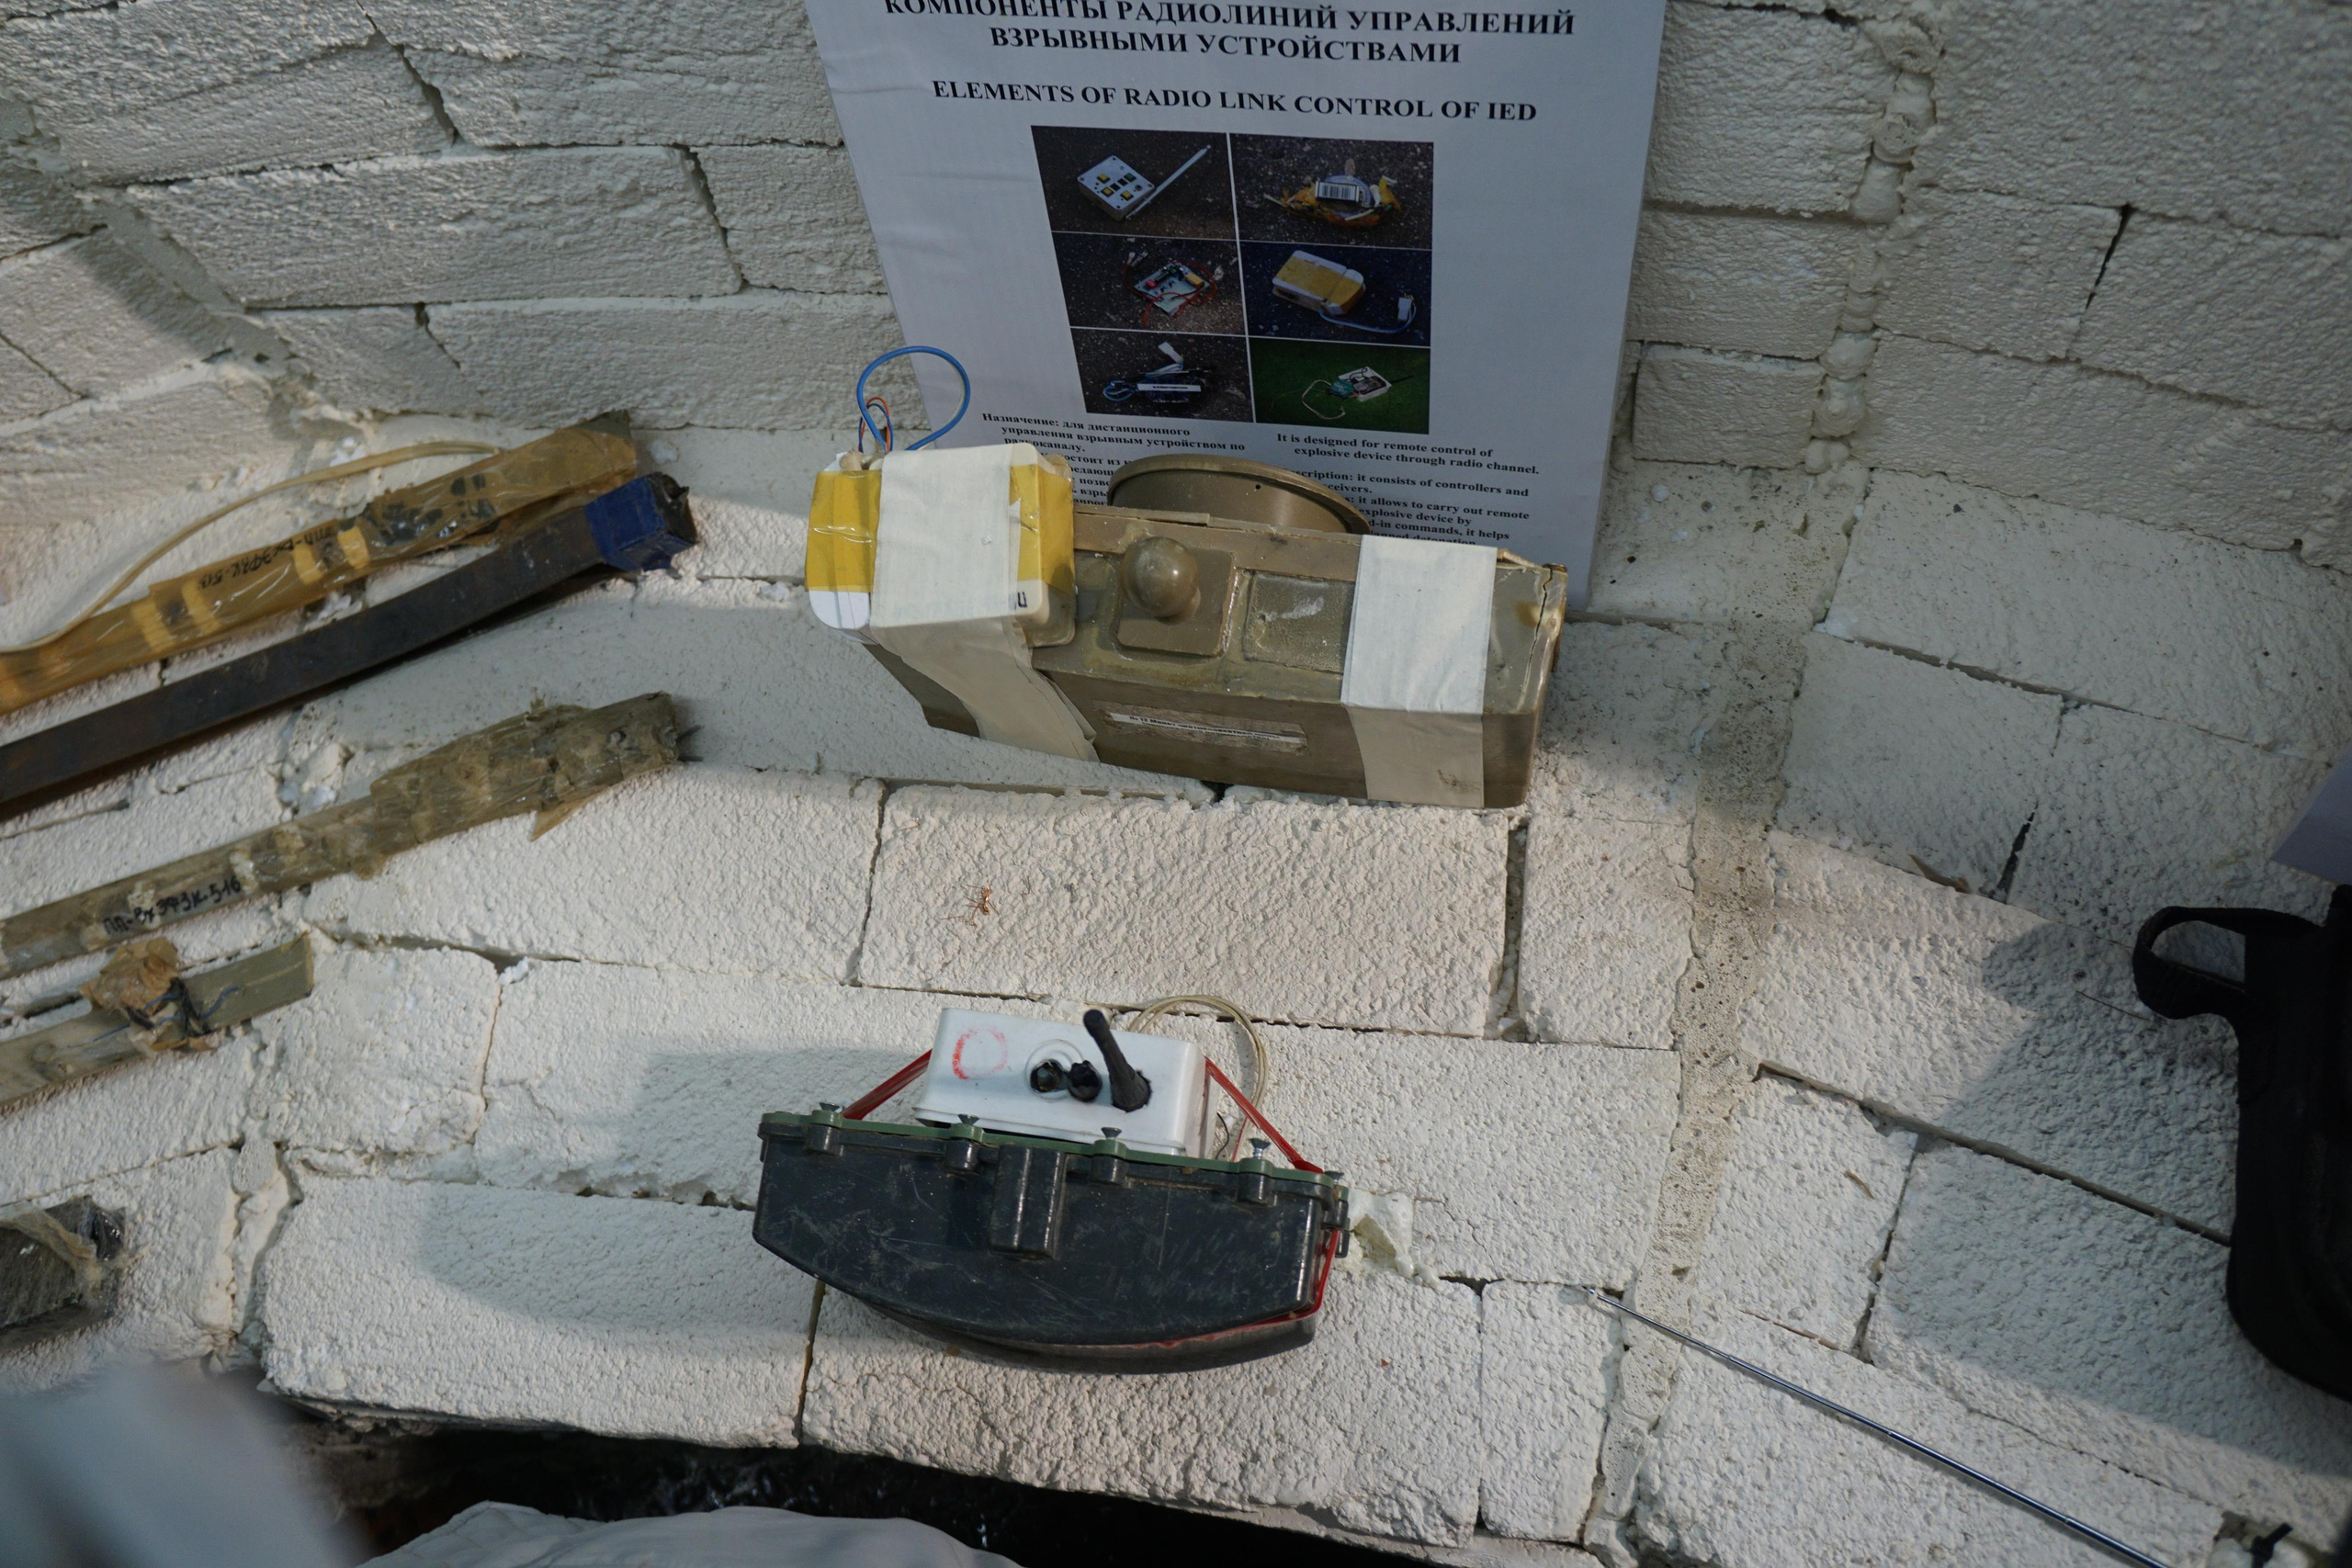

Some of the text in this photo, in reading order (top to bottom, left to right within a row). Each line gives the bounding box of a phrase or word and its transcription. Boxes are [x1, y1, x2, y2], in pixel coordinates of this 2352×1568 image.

[885, 0, 1575, 35] КОМПОНЕНТЫ РАДИОЛИНИЙ УПРАВЛЕНИЙ
[989, 28, 1462, 62] ВЗРЫВНЫМИ УСТРОЙСТВАМИ
[933, 80, 1537, 120] ELEMENTS OF RADIO LINK CONTROL OF IED
[982, 412, 1190, 436] Назначение: для дистанционного
[1001, 426, 1245, 451] управления взрывным устройством по
[1277, 433, 1494, 457] It is designed for remote control of
[1064, 455, 1103, 466] остоит
[1295, 446, 1540, 475] explosive device through radio channel.
[1293, 468, 1529, 498] scription: it consists of controllers and
[1325, 483, 1374, 494] ceivers.
[1359, 496, 1368, 504] it
[1370, 498, 1408, 509] allows
[1411, 501, 1423, 510] to
[1427, 503, 1459, 515] carry
[1463, 507, 1483, 516] out
[1487, 509, 1530, 520] remote
[1360, 508, 1472, 526] explosive device by
[1466, 528, 1476, 536] it
[1478, 529, 1510, 541] helps
